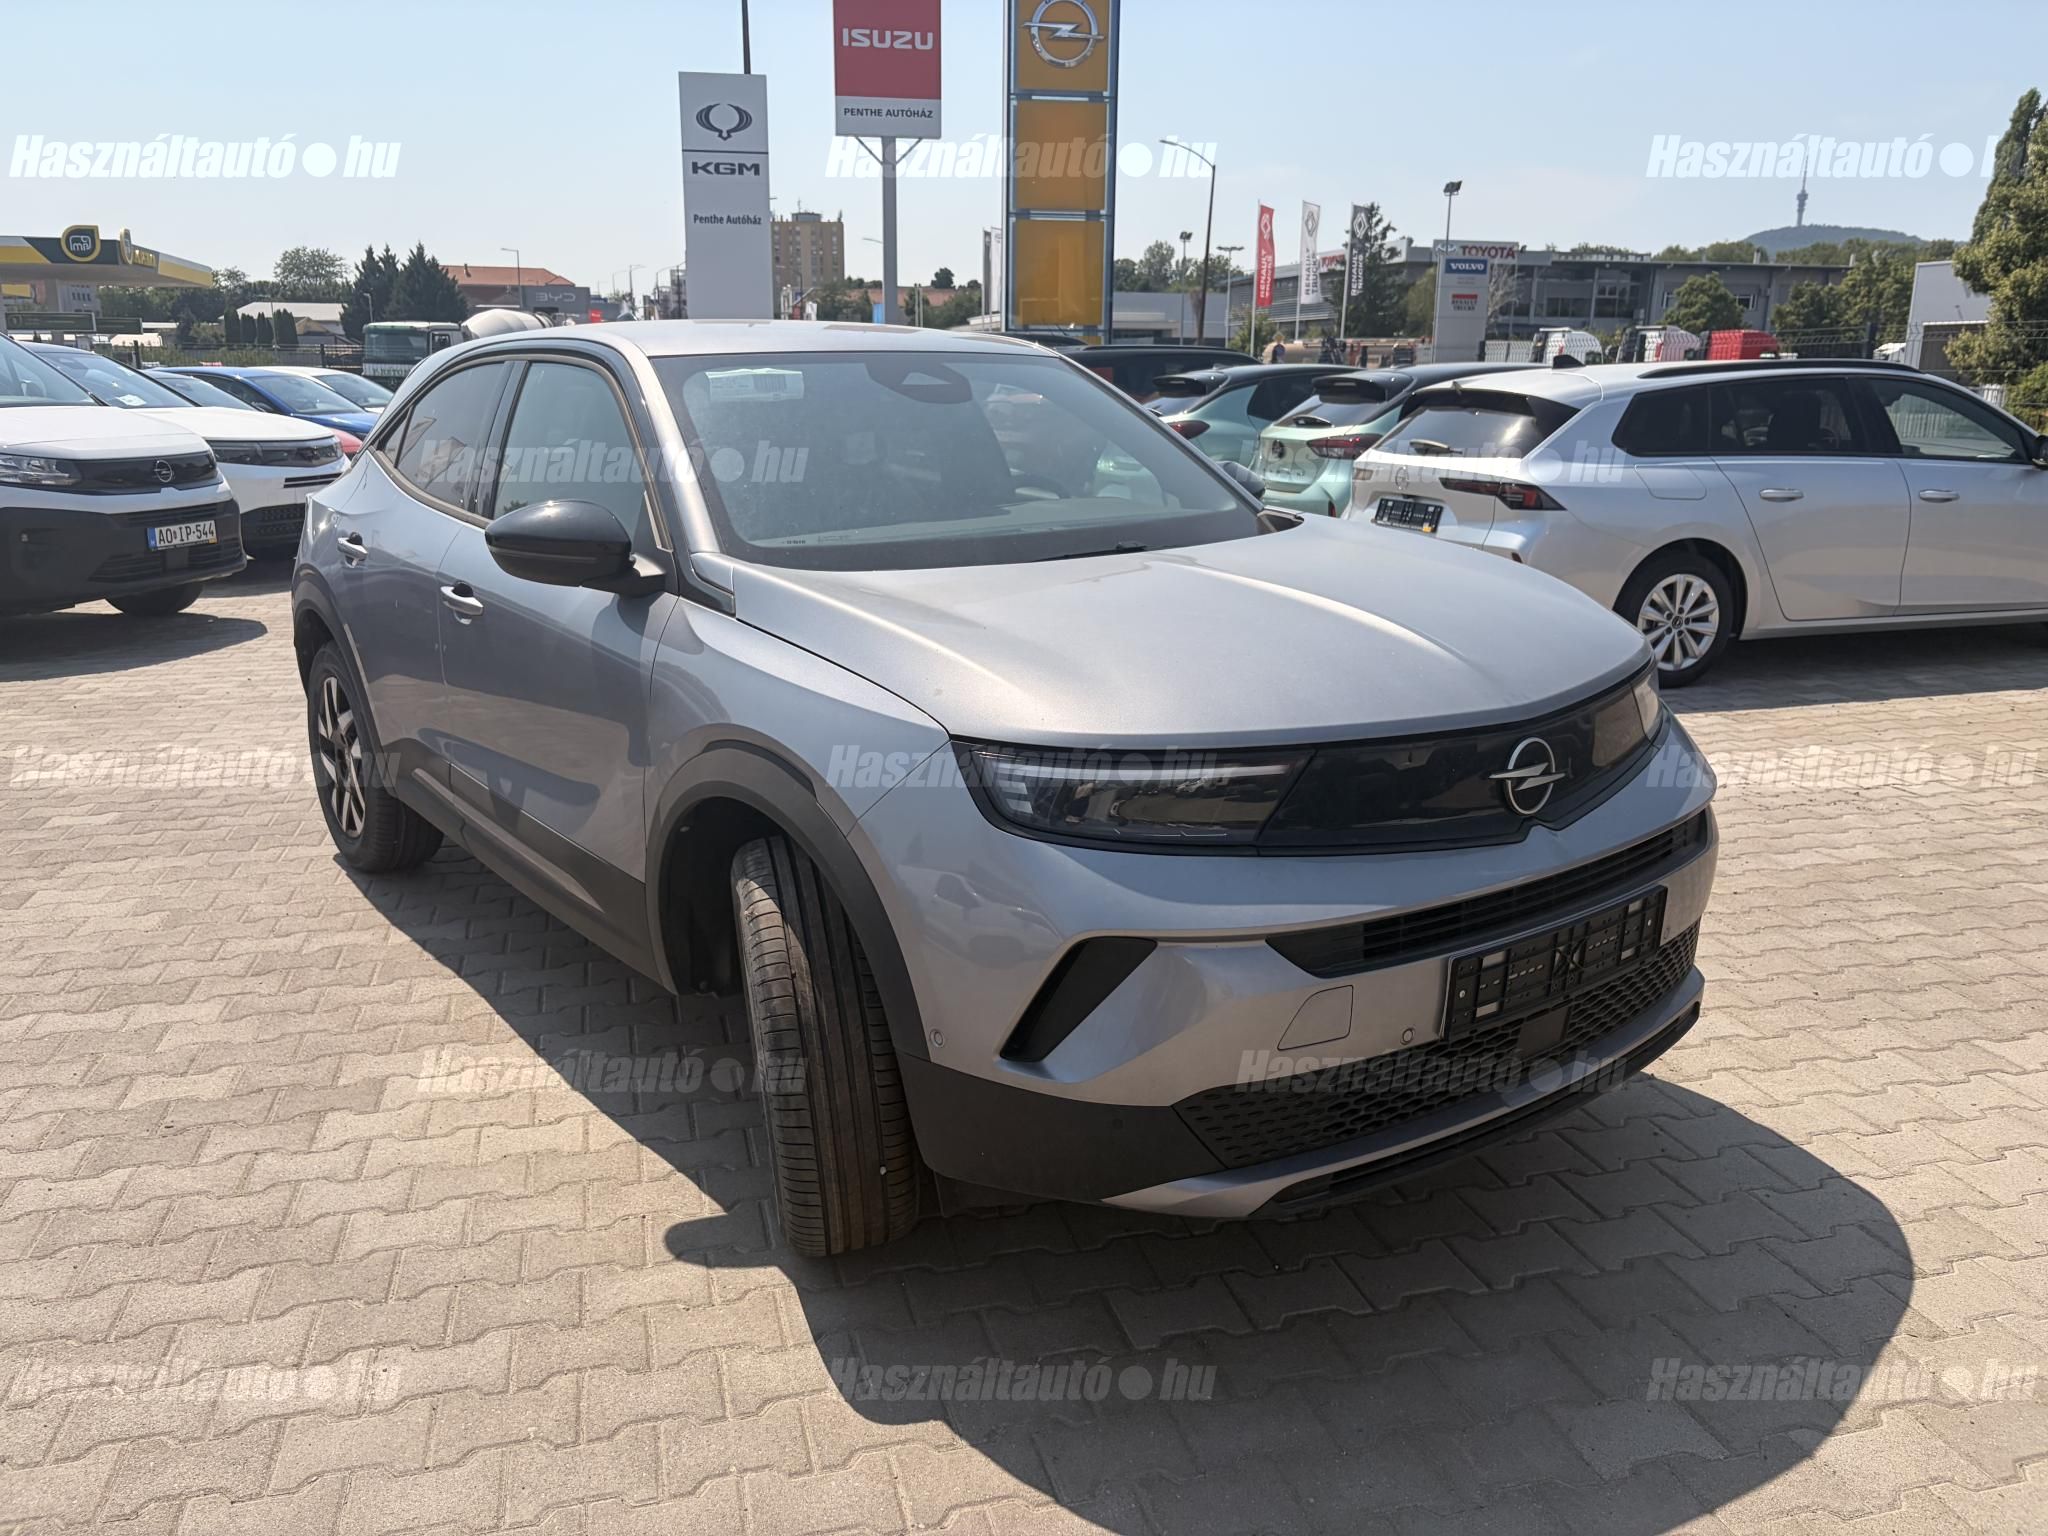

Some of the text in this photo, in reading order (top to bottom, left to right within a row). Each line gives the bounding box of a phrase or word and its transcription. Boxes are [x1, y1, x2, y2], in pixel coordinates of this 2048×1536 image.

[842, 27, 934, 50] ISUZU
[843, 107, 934, 118] PENTHE AUTÓHÁZ
[691, 161, 760, 176] KGM
[693, 213, 762, 226] Penthe Autóház
[1460, 244, 1516, 259] TOYOTA
[1449, 263, 1485, 271] VOLVO
